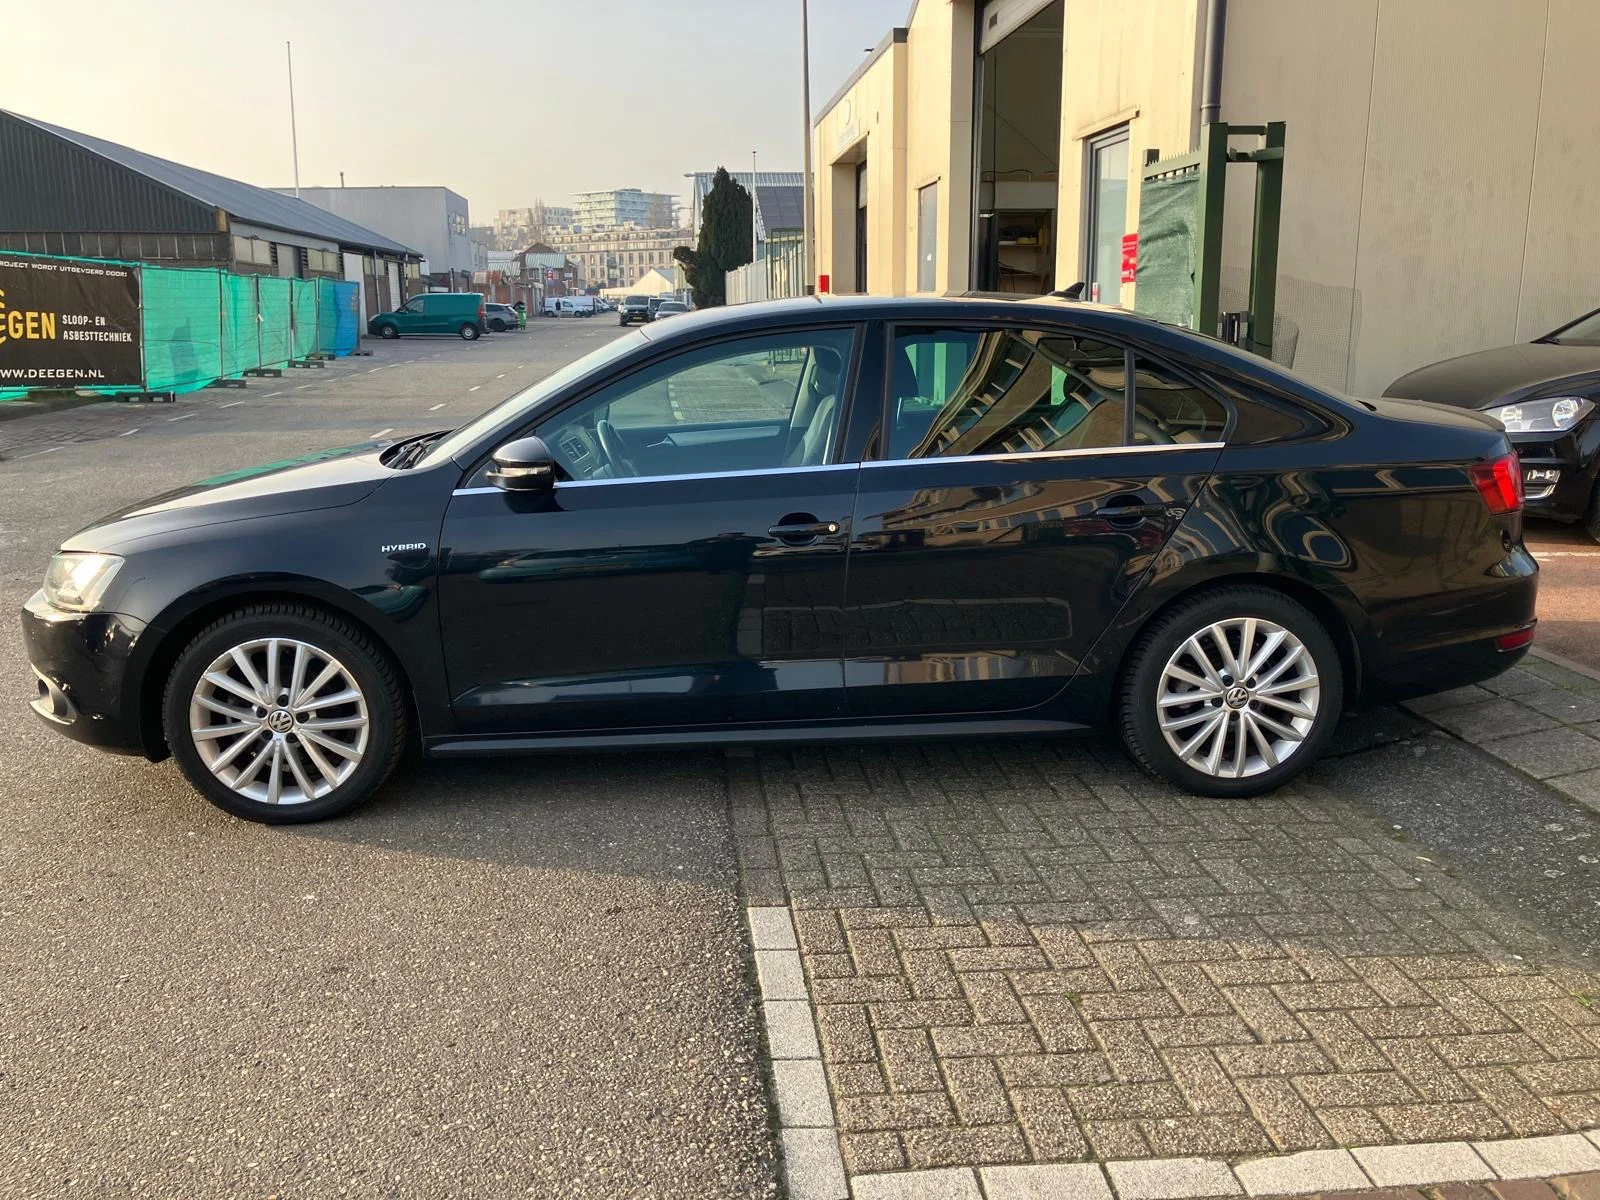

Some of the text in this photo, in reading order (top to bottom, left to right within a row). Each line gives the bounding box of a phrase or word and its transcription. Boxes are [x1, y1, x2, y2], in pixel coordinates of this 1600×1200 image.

[60, 264, 104, 275] UITGEVOERD
[62, 314, 105, 326] SLOOP- EN
[63, 330, 132, 342] ASBESTTECHNIEK
[381, 542, 427, 552] HYBRID
